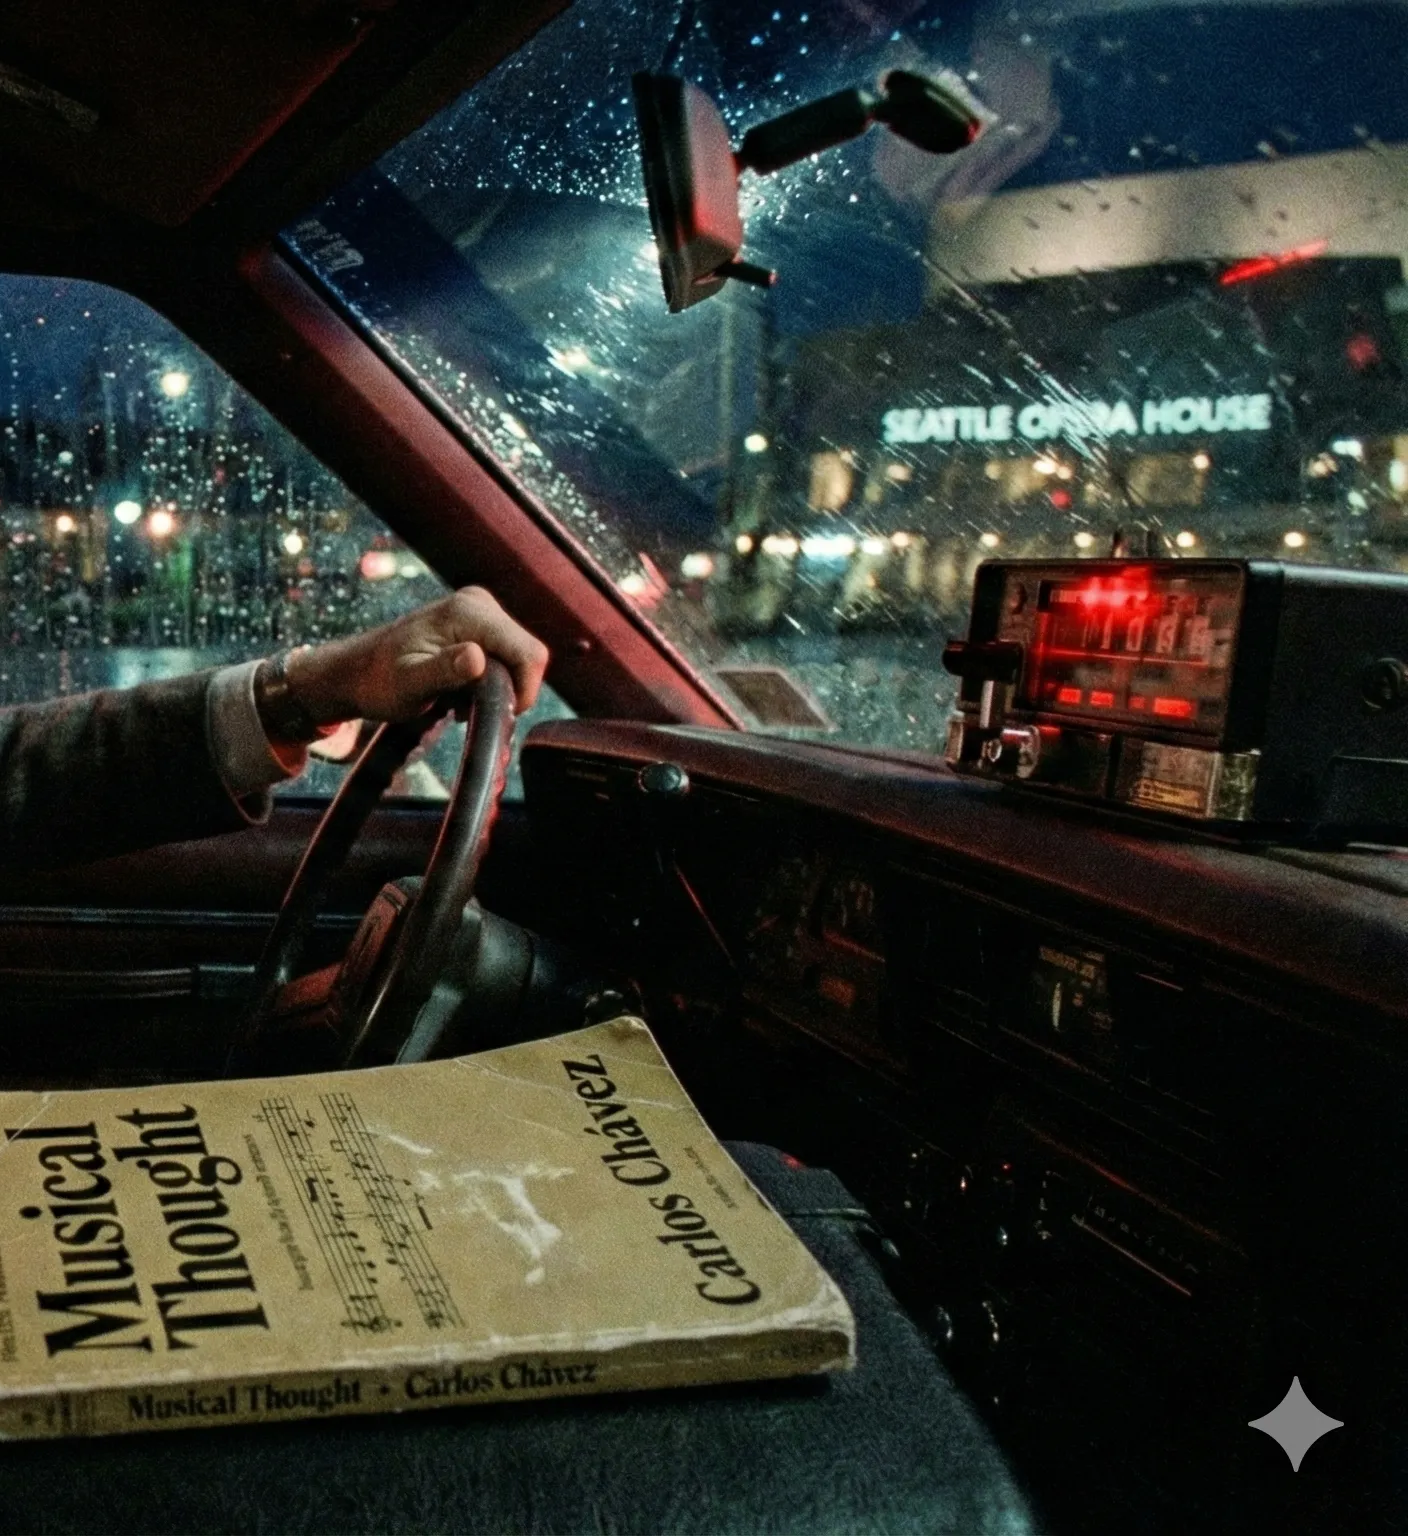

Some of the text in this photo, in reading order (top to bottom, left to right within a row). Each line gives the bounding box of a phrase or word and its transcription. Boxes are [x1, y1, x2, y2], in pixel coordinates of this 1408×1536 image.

[882, 404, 1013, 443] SEATTLE
[1143, 393, 1272, 435] HOUSE
[561, 1053, 672, 1187] Chávez
[3, 1121, 153, 1358] Musical
[112, 1103, 270, 1351] Thought
[648, 1193, 761, 1306] Carlos
[127, 1358, 598, 1423] Musical Thought Carlos Chávez
